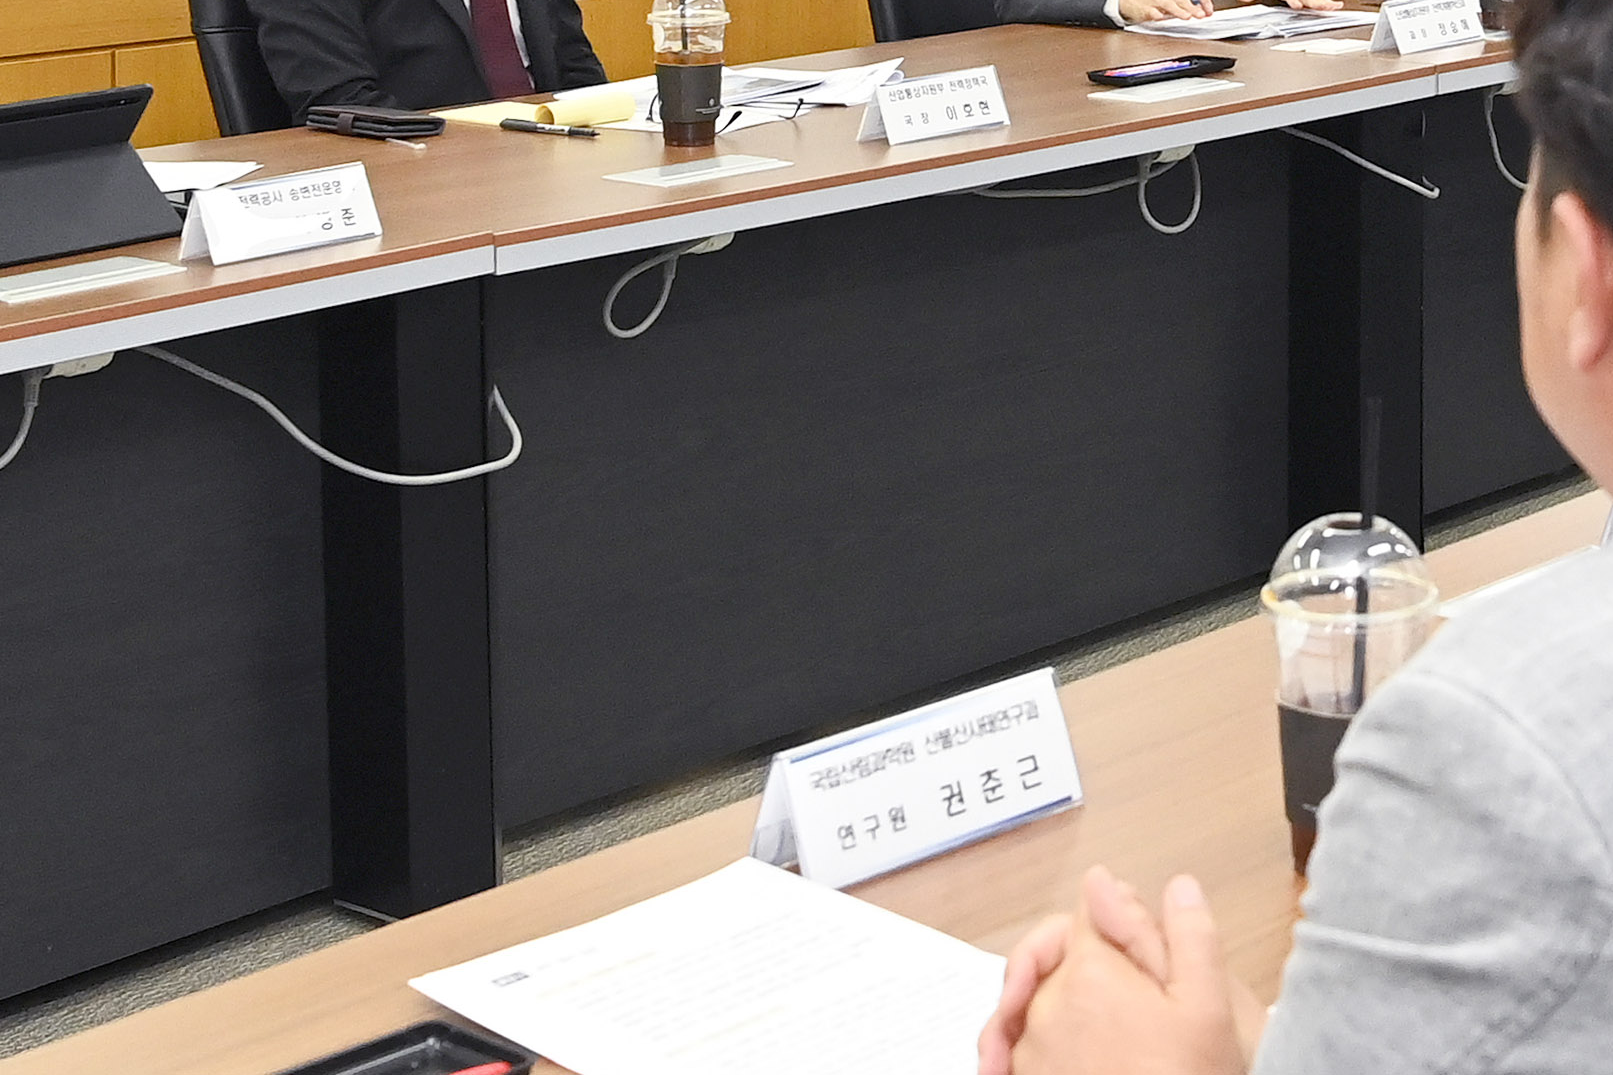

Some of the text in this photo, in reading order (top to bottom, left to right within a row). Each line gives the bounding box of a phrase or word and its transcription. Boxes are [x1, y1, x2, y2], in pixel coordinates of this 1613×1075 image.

[888, 83, 945, 102] 산업통상자원부
[837, 754, 1043, 852] 연구원 권준근
